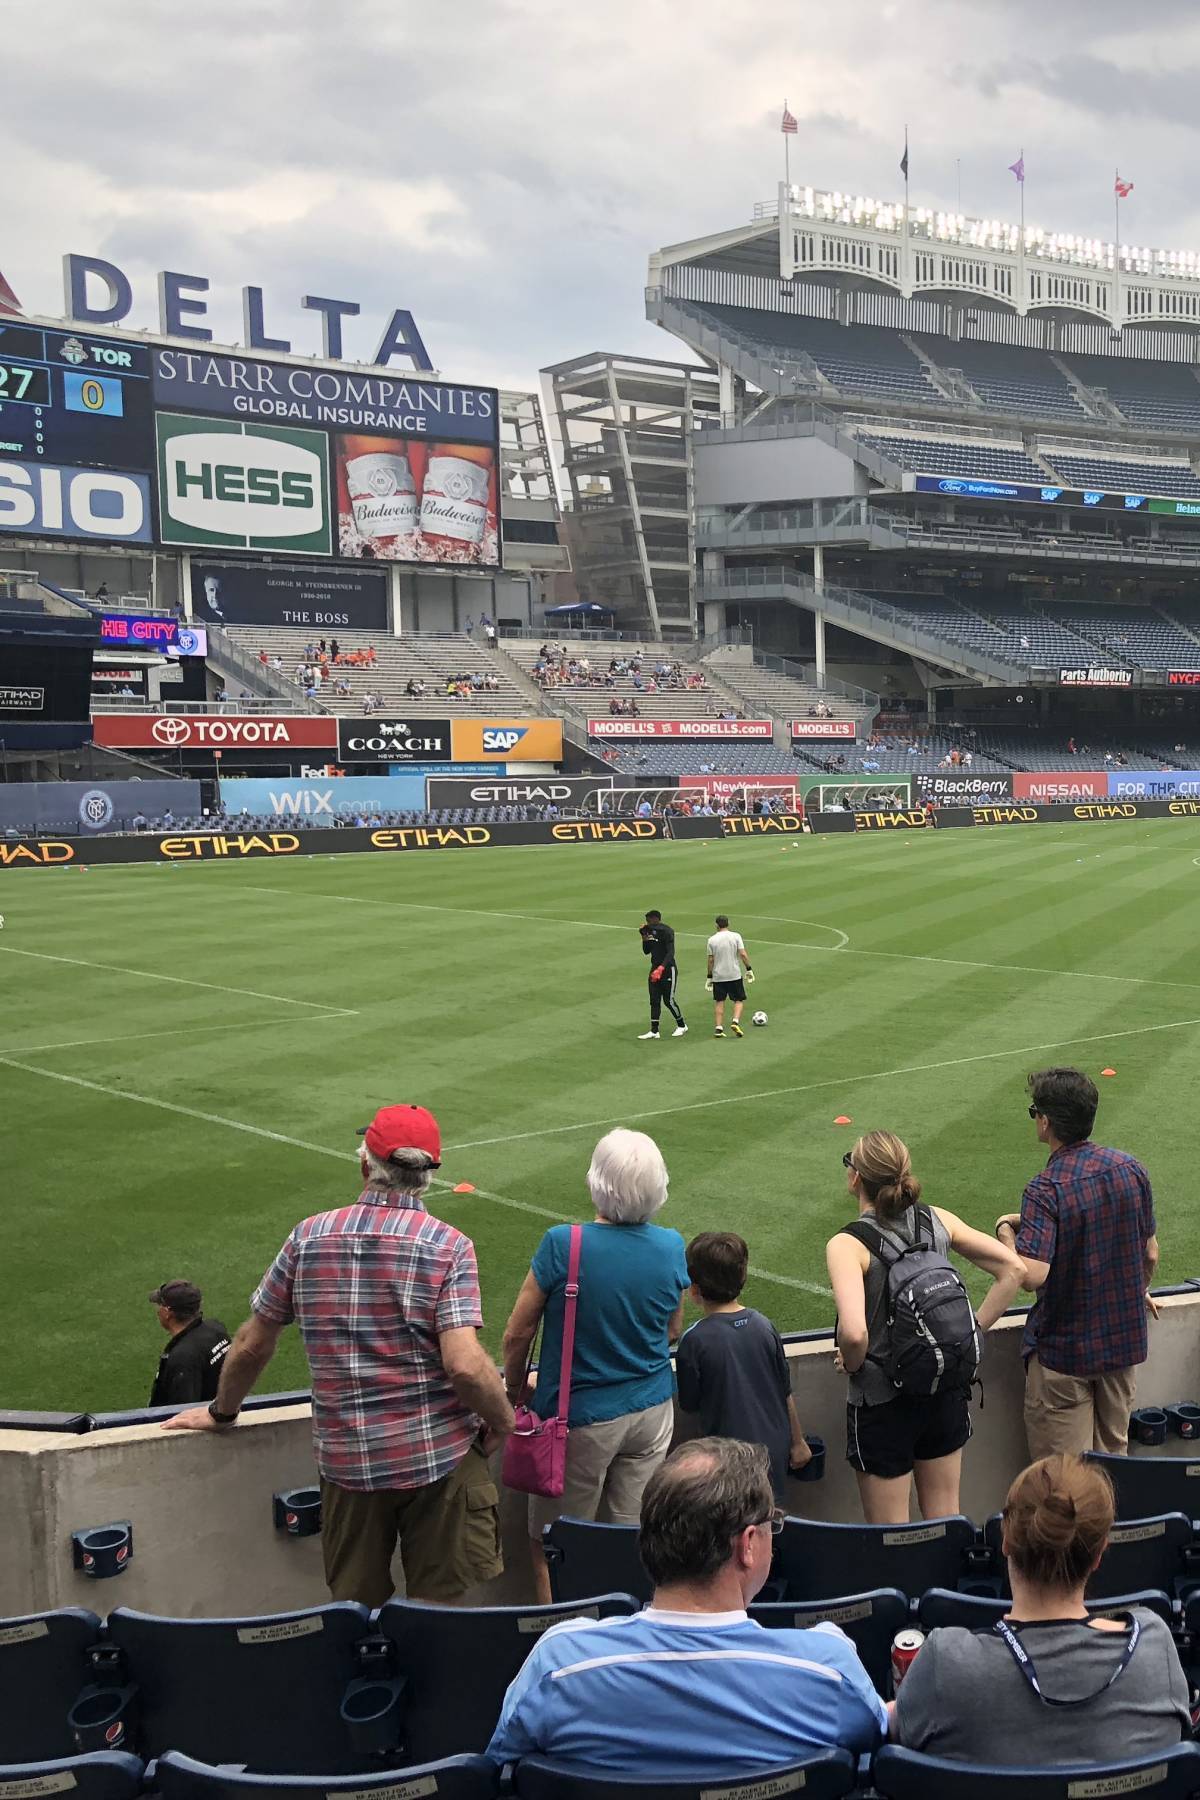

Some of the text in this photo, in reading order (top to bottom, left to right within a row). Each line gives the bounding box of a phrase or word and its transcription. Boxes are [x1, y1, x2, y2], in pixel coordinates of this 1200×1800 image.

[62, 253, 434, 371] DELTA
[91, 347, 132, 368] TOR
[158, 351, 492, 418] STARR COMPANIES
[81, 379, 105, 410] 0
[233, 395, 427, 432] GLOBAL INSURANCE
[175, 460, 314, 509] HESS
[1041, 490, 1058, 500] SAP
[1084, 494, 1100, 505] SAP
[1125, 499, 1141, 508] SAP
[283, 610, 349, 625] THE BOSS
[132, 621, 176, 640] CITY
[1061, 668, 1131, 682] Parts Authority
[194, 721, 290, 742] TOYOTA
[594, 722, 655, 734] MODELL'S
[679, 723, 767, 735] MODELLS.com
[798, 725, 849, 735] MODELL'S
[348, 738, 442, 751] COACH
[483, 731, 519, 750] SAP
[301, 765, 346, 777] FedEx
[470, 785, 572, 802] ETIHAD
[934, 779, 1008, 795] BlackBerry
[1030, 784, 1094, 796] NISSAN
[1117, 783, 1145, 795] FOR
[1149, 782, 1175, 795] THE
[973, 807, 1038, 823] ETIHAD
[1074, 804, 1137, 819] ETIHAD
[371, 826, 490, 848] ETIHAD
[552, 821, 657, 840] ETIHAD
[160, 833, 300, 857] ETIHAD
[1005, 1631, 1028, 1663] MEMBER
